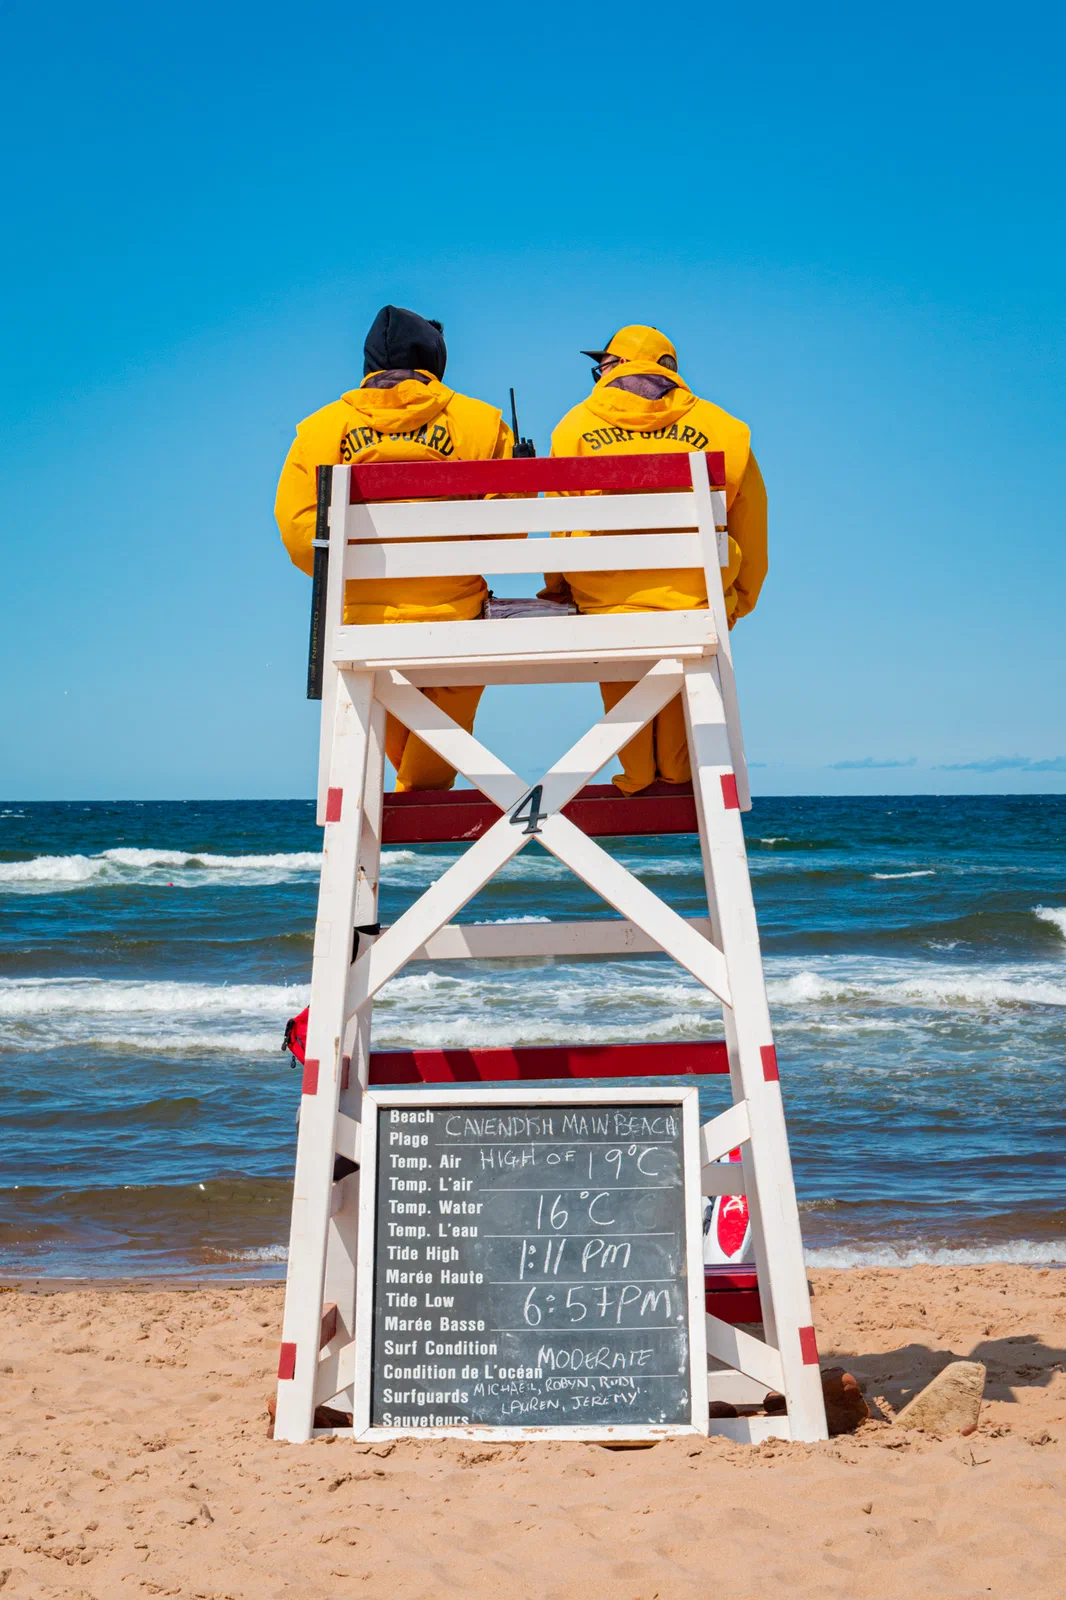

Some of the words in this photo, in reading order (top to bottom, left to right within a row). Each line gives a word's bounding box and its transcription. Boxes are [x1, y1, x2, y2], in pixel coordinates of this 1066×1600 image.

[509, 785, 548, 834] 4
[390, 1110, 434, 1123] Beach
[562, 1112, 609, 1136] MAIN
[615, 1112, 677, 1137] BEACH
[389, 1132, 429, 1148] Plage
[389, 1154, 432, 1171] Temp.
[439, 1154, 462, 1168] Air
[480, 1144, 536, 1169] HIGH
[546, 1150, 577, 1165] OF
[388, 1177, 432, 1193] Temp.
[439, 1177, 474, 1191] L'air
[388, 1200, 431, 1216] Temp.
[438, 1200, 484, 1214] Water
[387, 1223, 431, 1239] Temp.
[438, 1223, 478, 1237] L'eau
[387, 1246, 419, 1260] Tide
[426, 1246, 459, 1263] High
[519, 1238, 567, 1280] 1:11
[385, 1269, 433, 1284] Marée
[440, 1269, 484, 1284] Haute
[386, 1293, 418, 1308] Tide
[425, 1293, 455, 1308] Low
[384, 1316, 432, 1331] Marée
[440, 1317, 485, 1331] Basse
[384, 1340, 418, 1355] Surf
[425, 1340, 498, 1355] Condition
[538, 1345, 654, 1371] MODERATE
[383, 1364, 456, 1379] Condition
[461, 1365, 479, 1379] de
[484, 1364, 543, 1379] L'océan
[383, 1388, 469, 1406] Surfguards
[382, 1412, 469, 1427] Sauveteurs
